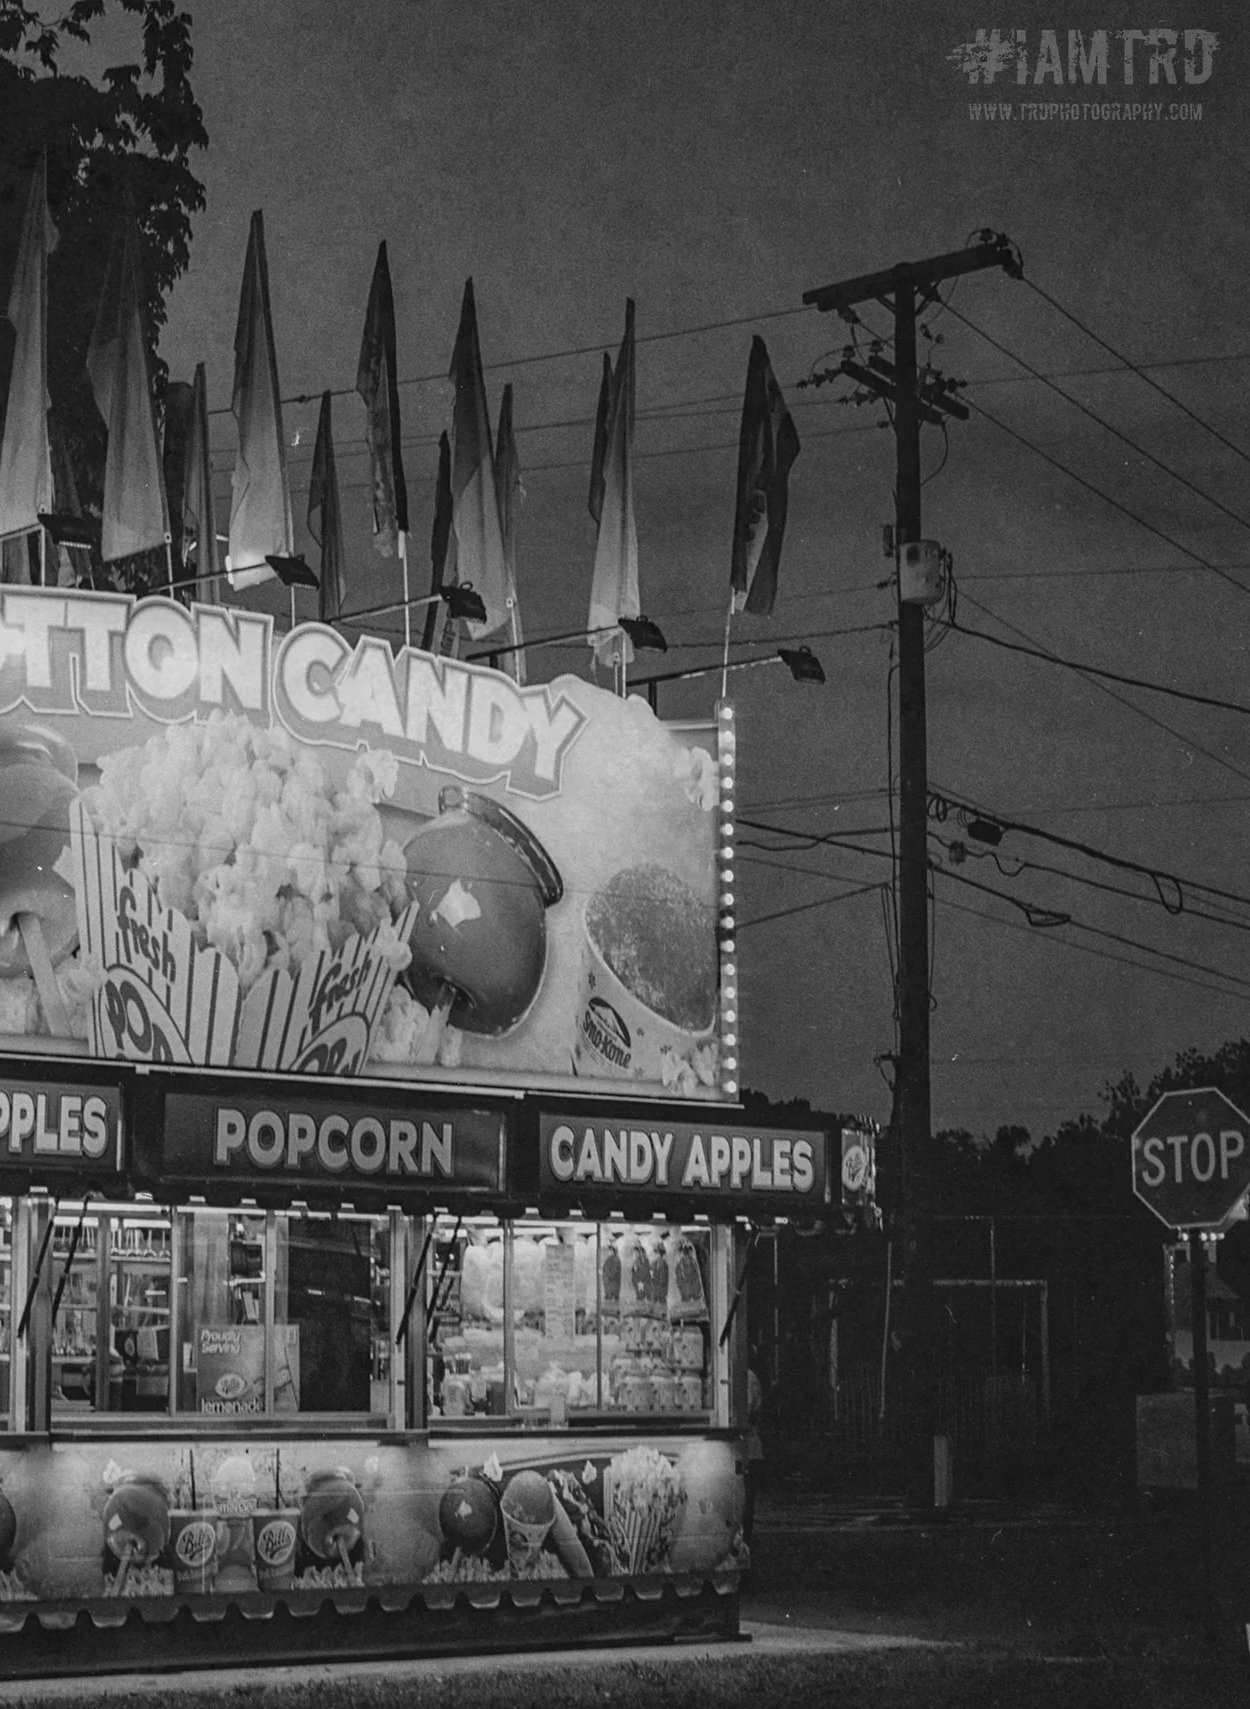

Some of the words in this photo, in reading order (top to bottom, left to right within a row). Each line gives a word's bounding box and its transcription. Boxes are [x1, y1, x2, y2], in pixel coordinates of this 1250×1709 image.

[279, 630, 584, 782] CANDY
[213, 1107, 454, 1177] POPCORN
[550, 1123, 673, 1186] CANDY
[683, 1134, 815, 1192] APPLES
[1141, 1129, 1245, 1187] STOP
